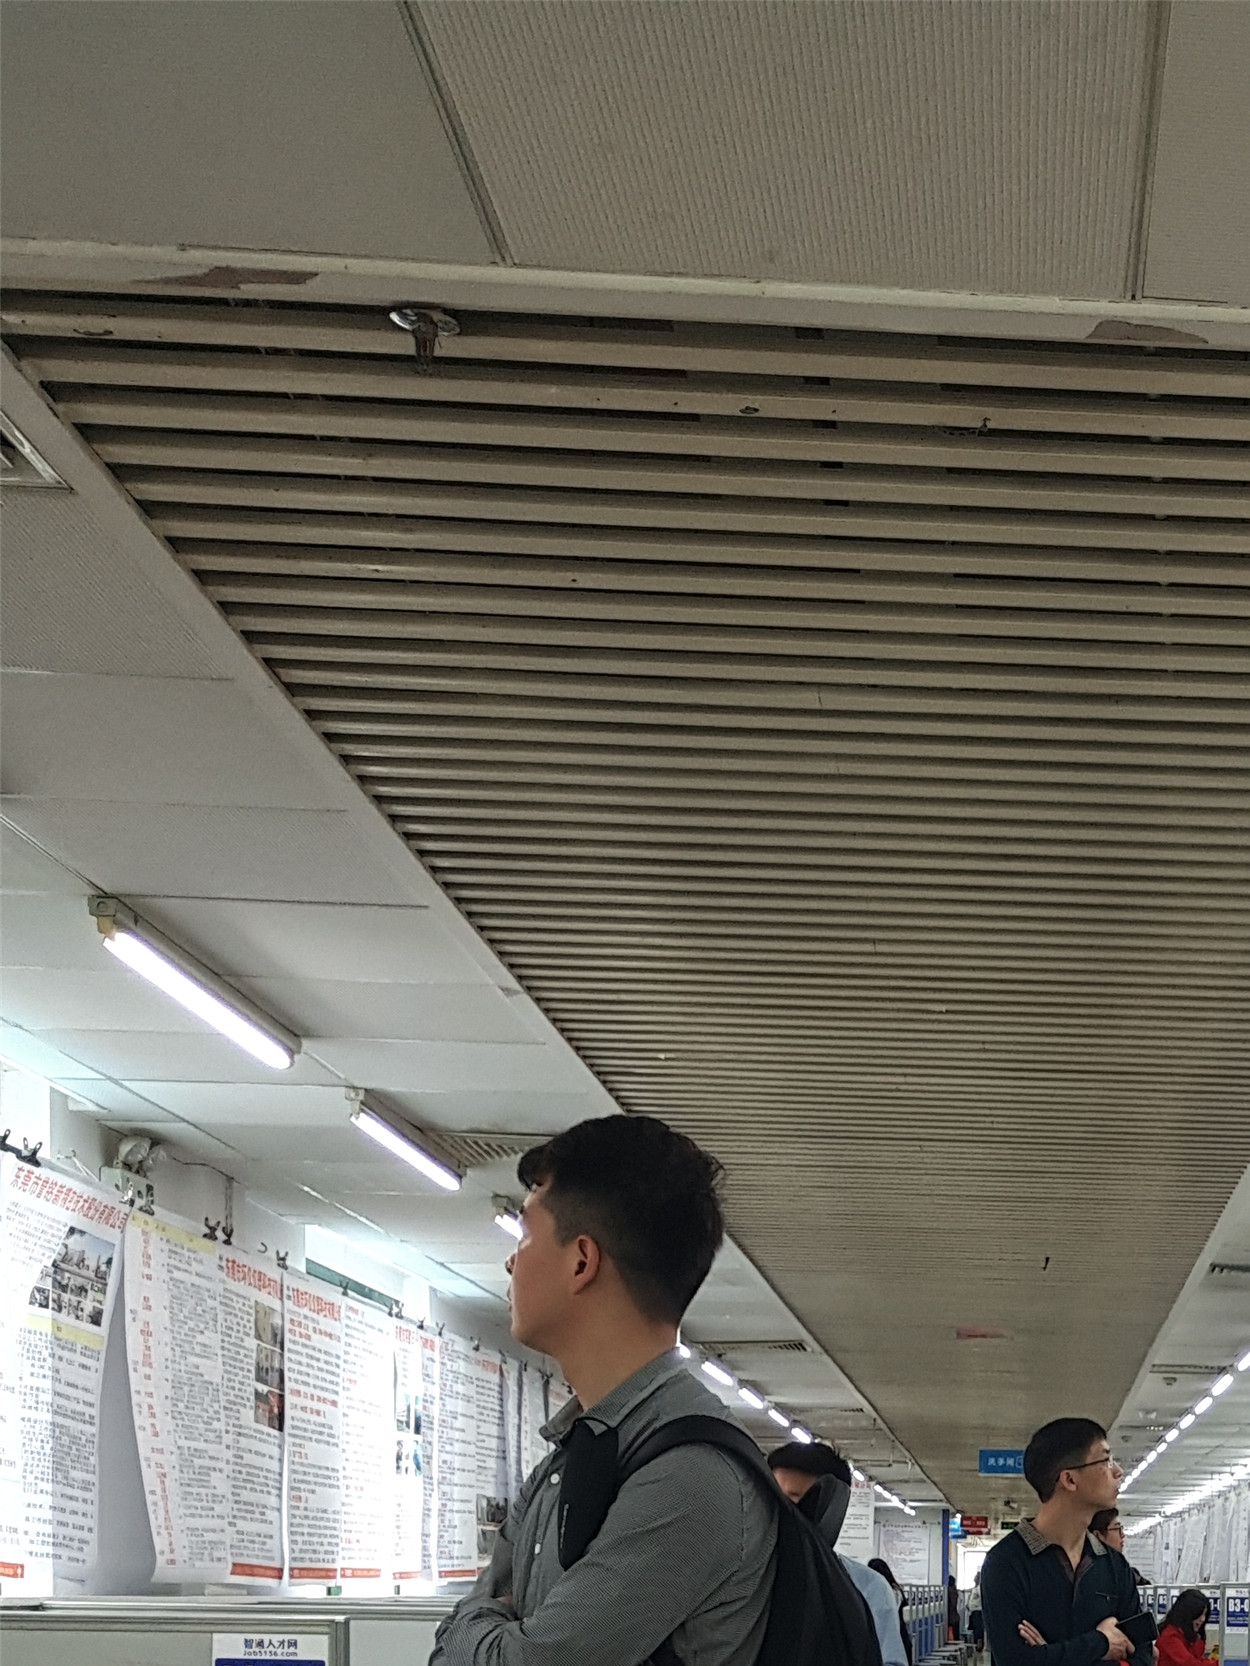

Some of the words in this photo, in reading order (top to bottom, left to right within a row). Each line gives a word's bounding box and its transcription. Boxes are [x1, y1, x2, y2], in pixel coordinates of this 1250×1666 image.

[243, 1638, 298, 1650] 智通人才网
